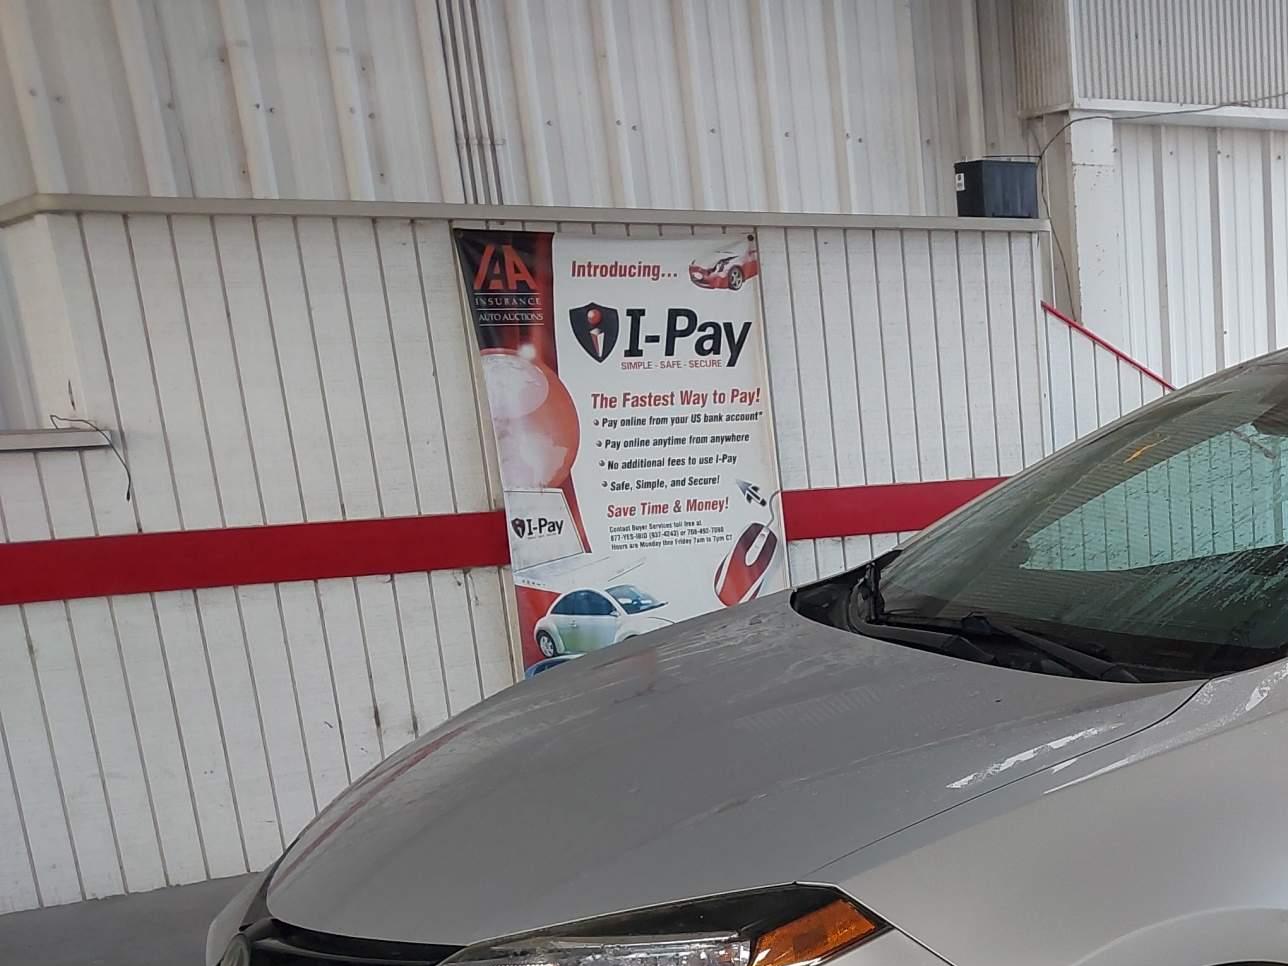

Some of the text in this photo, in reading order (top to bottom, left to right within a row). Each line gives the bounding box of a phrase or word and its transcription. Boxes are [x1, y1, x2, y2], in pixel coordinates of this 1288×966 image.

[572, 260, 678, 281] Introducing...
[475, 298, 542, 306] INSURANCE
[624, 308, 752, 367] I-Pay
[621, 361, 653, 370] SIMPLE
[689, 360, 722, 368] SECURE
[591, 388, 761, 409] The Fastest Way to Pay!
[602, 417, 618, 429] Pay
[620, 416, 646, 427] online
[650, 416, 668, 425] from
[670, 416, 688, 426] your
[691, 414, 702, 424] US
[704, 413, 723, 423] bank
[605, 434, 750, 450] Pay online anytime from anywhere
[608, 454, 737, 470] No additional fees to use I-Pay
[610, 475, 720, 491] Safe, Simple, and Secure!
[607, 497, 729, 518] Save Time & Money!
[526, 518, 564, 536] I-Pay
